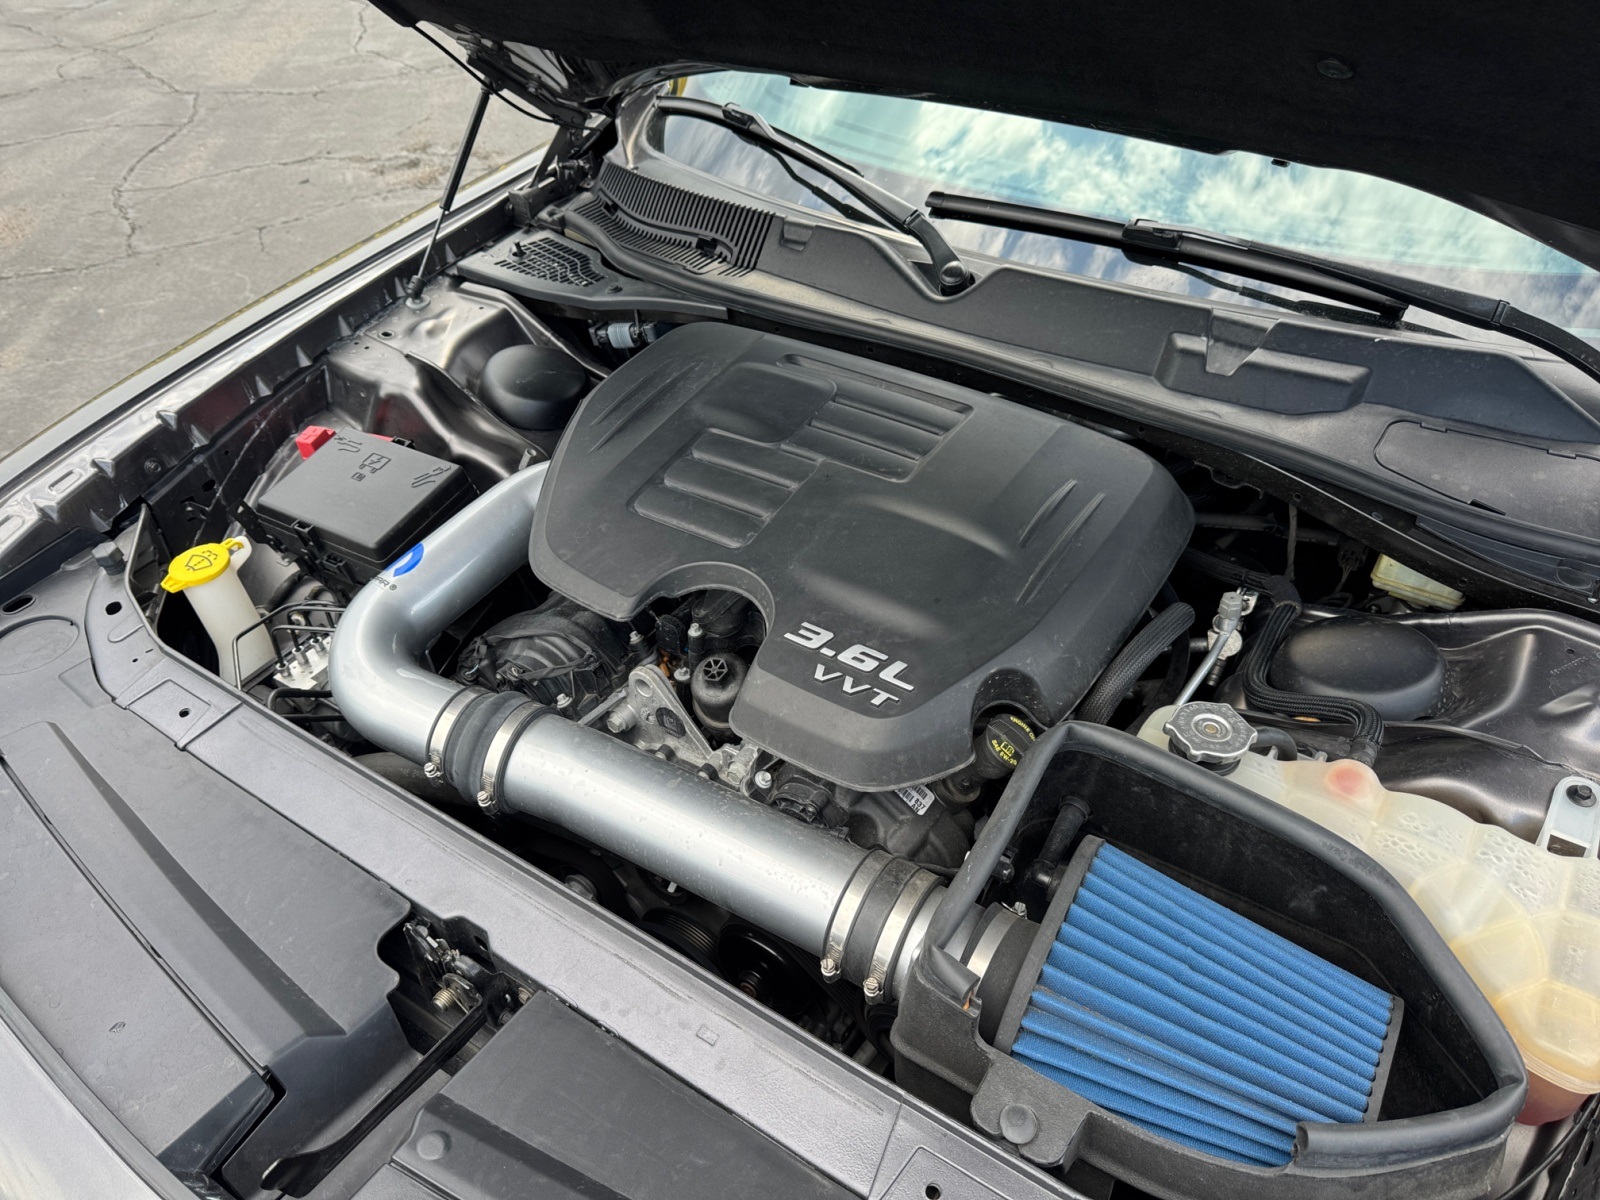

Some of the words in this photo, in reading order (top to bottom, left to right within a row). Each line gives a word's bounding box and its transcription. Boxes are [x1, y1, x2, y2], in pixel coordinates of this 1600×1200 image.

[783, 621, 915, 692] 3.6L
[814, 663, 900, 706] VVT
[1010, 716, 1031, 733] ENGINE
[991, 739, 1001, 752] SAE
[914, 798, 926, 810] 837
